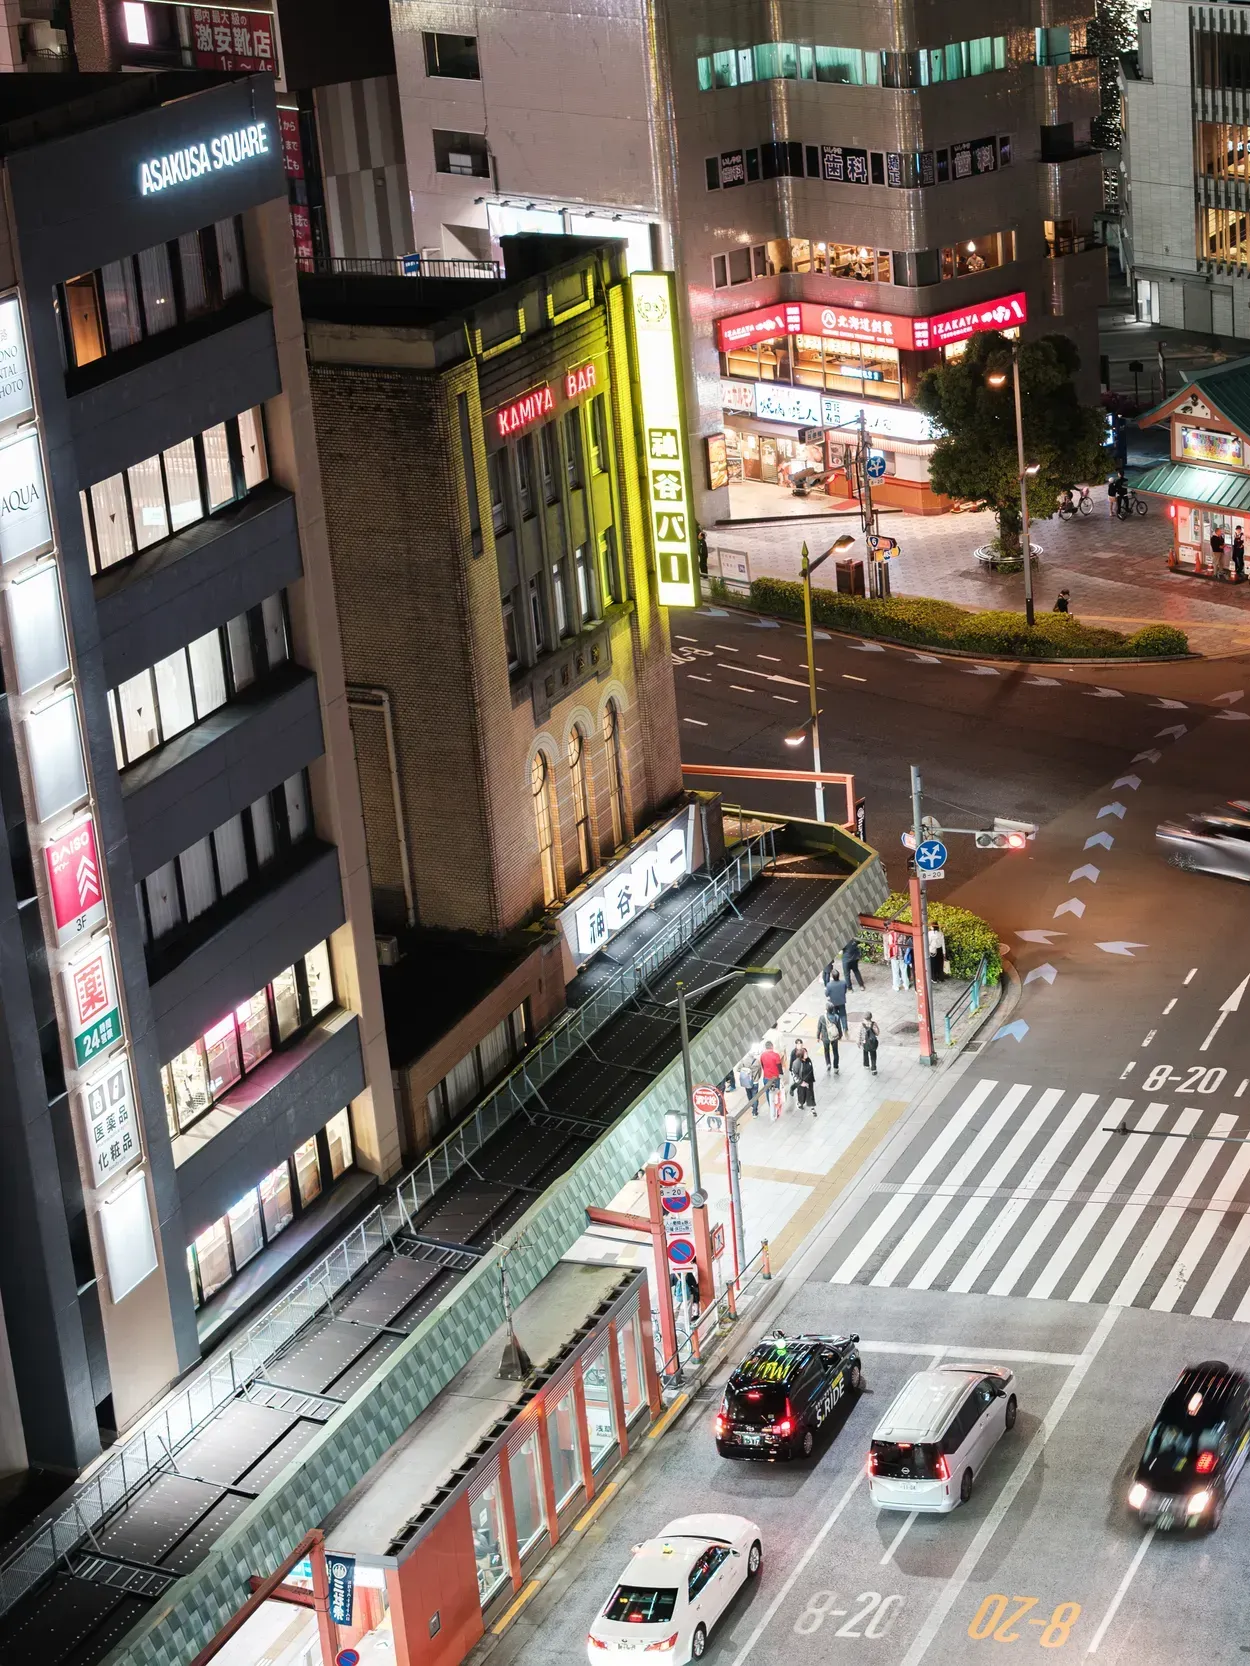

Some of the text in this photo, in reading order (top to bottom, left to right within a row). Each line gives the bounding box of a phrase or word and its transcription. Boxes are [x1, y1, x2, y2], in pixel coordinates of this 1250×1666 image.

[194, 8, 247, 25] 都内最大級の
[195, 24, 271, 58] 激安靴店
[142, 123, 268, 195] ASAKUSA SQUARE
[722, 164, 743, 182] 歯科
[824, 154, 867, 182] 歯科
[955, 145, 994, 178] 歯科
[933, 314, 979, 336] IZAKAYA
[499, 364, 597, 436] KAMIYA BAR
[1, 483, 39, 517] AQUA
[649, 430, 688, 583] 神谷バー
[51, 831, 89, 867] DAISO
[922, 871, 942, 879] 8-20
[589, 848, 684, 944] 神谷バー
[76, 915, 87, 932] 3F
[77, 963, 105, 1018] 薬
[83, 1028, 100, 1058] 24
[1141, 1064, 1228, 1094] 8-20
[94, 1105, 128, 1143] 医薬品
[98, 1132, 132, 1171] 化粧品
[660, 1189, 682, 1197] 8-20
[816, 1376, 845, 1428] S.RIDE
[793, 1589, 905, 1640] 8-20
[967, 1593, 1081, 1649] 8-20
